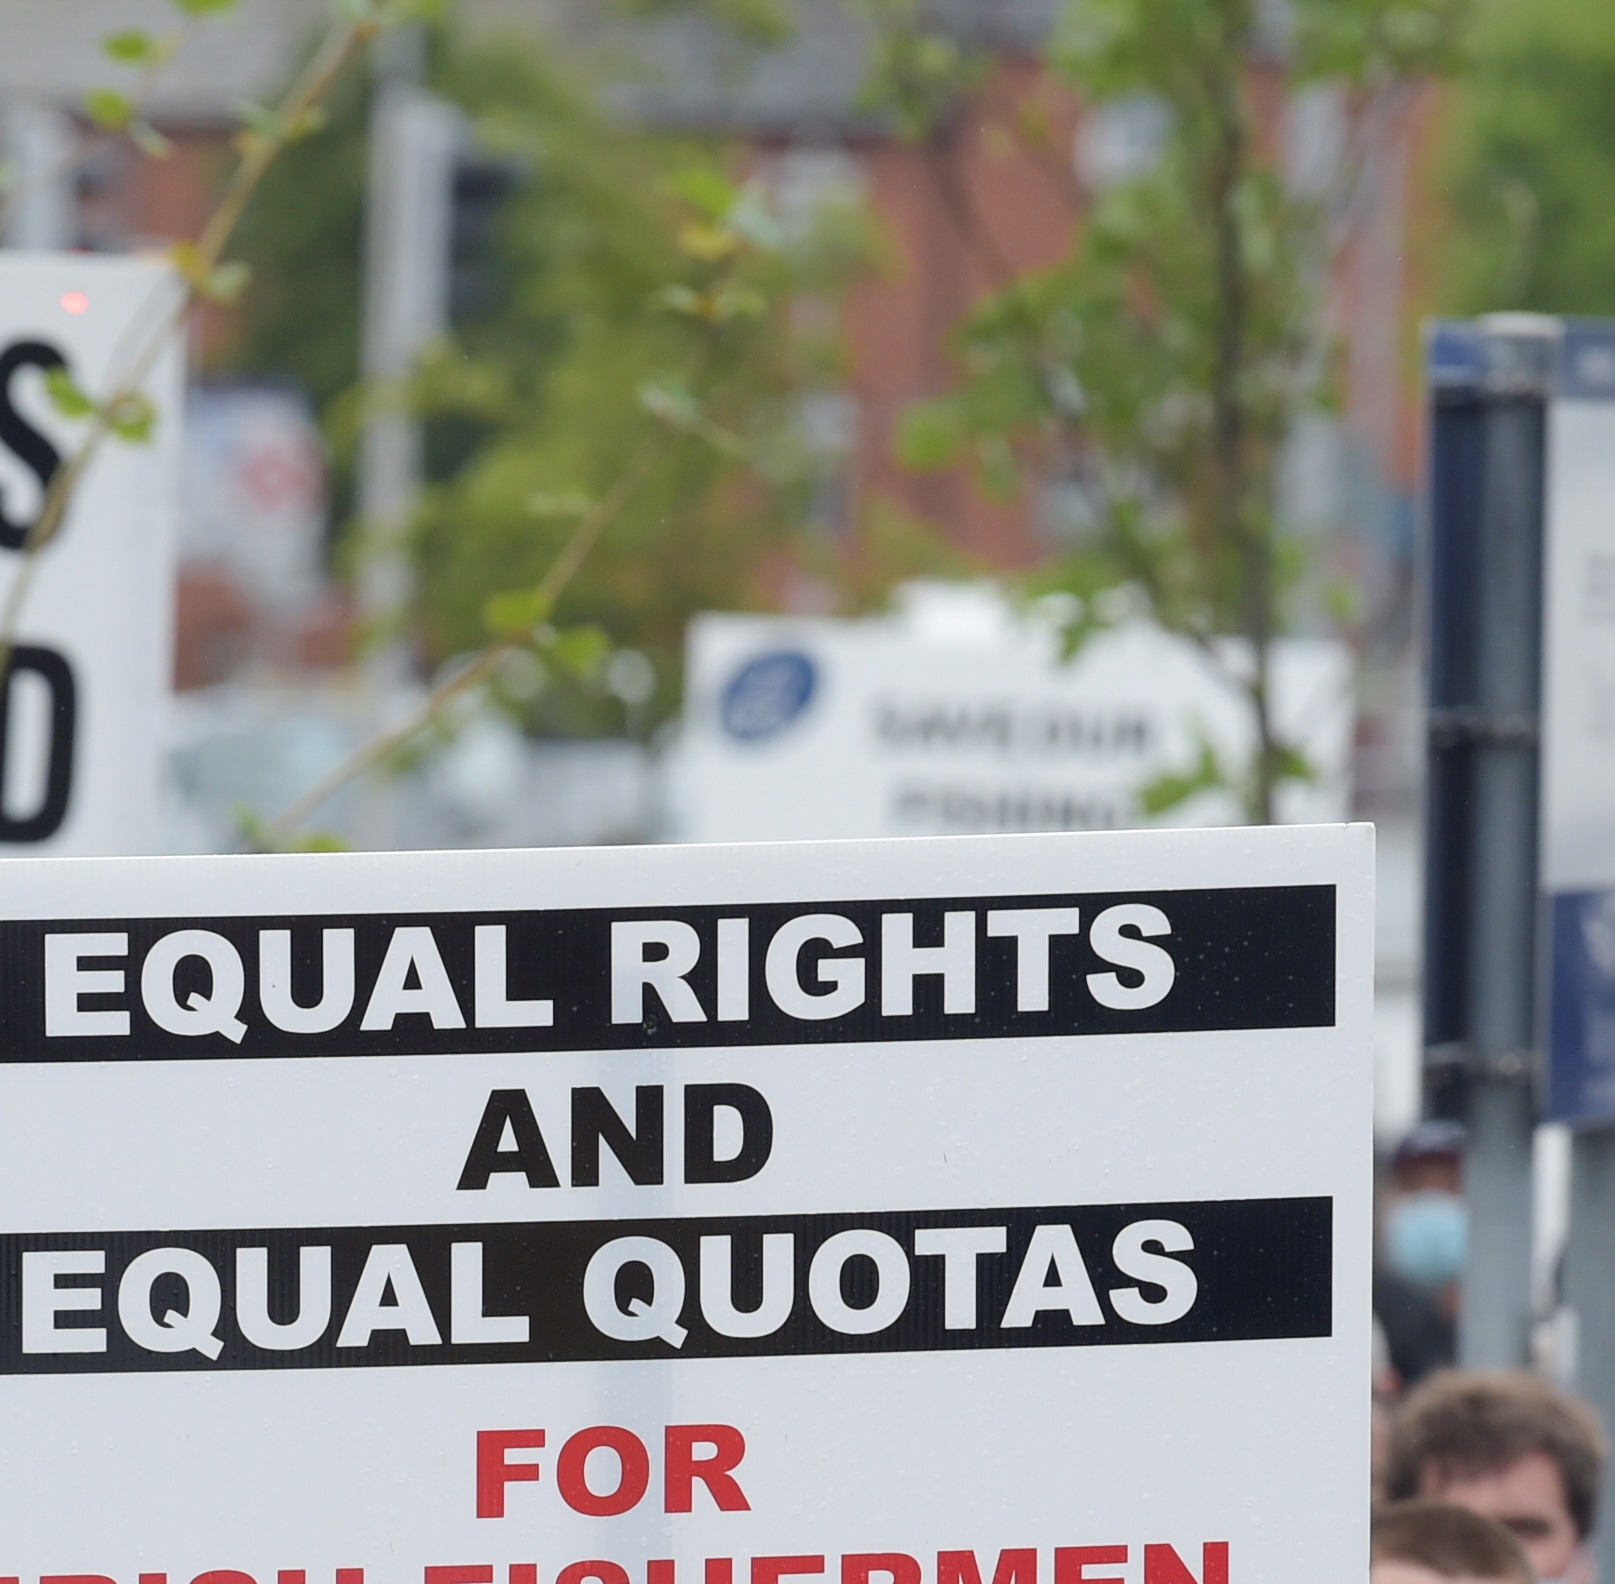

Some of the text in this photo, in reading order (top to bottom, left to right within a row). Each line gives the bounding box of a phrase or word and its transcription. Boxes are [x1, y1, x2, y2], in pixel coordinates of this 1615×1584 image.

[45, 903, 1177, 1044] EQUAL RIGHTS
[456, 1083, 774, 1191] AND
[21, 1219, 1199, 1361] EQUAL QUOTAS
[476, 1423, 751, 1519] FOR
